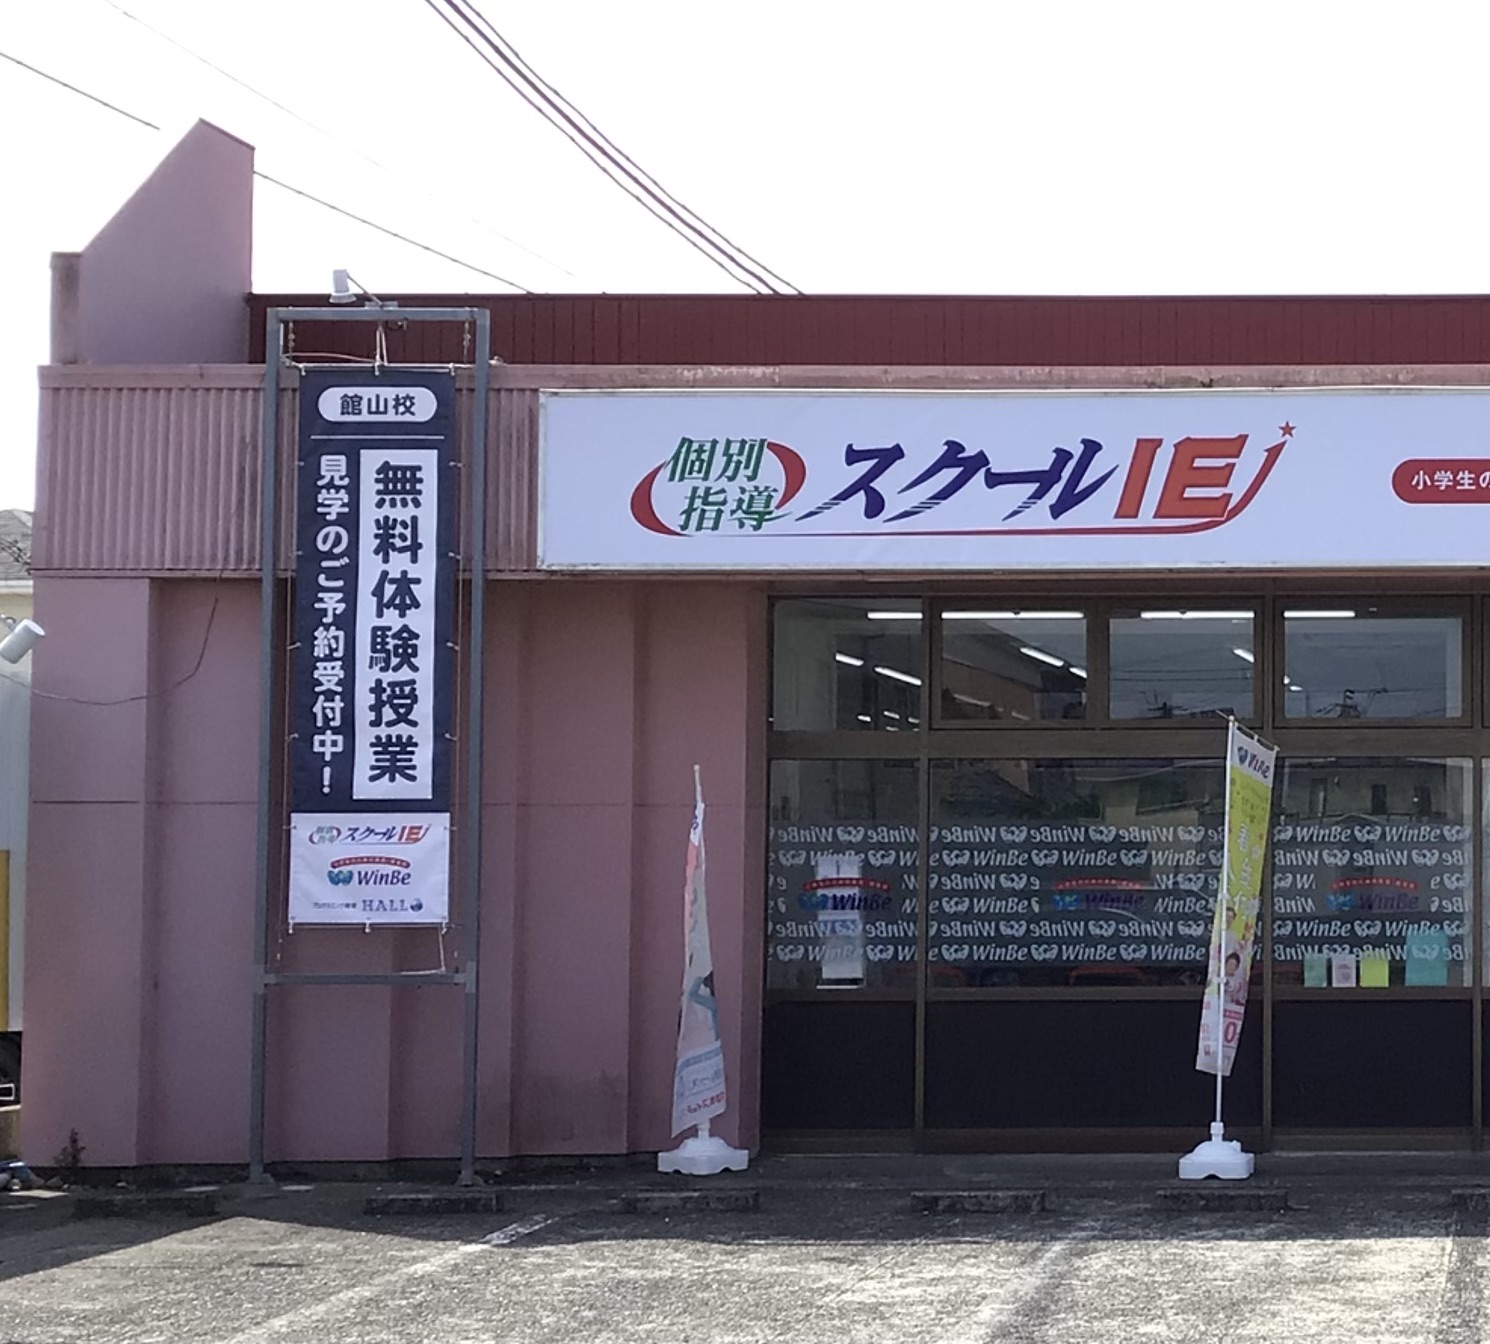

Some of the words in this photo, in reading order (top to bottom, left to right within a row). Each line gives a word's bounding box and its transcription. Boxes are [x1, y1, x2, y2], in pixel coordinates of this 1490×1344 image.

[339, 392, 417, 418] 館山校
[665, 436, 768, 482] 個別
[679, 485, 792, 532] 指導
[367, 460, 424, 785] 無料体験授業
[1296, 826, 1351, 843] WinBe
[1385, 826, 1440, 843] WinBe
[973, 850, 1028, 866] WinBe
[1062, 850, 1117, 866] WinBe
[1151, 850, 1206, 866] WinBe
[357, 869, 411, 886] WinBe
[973, 897, 1028, 913] WinBe
[1296, 920, 1351, 937] WinBe
[1385, 920, 1441, 937] WinBe
[972, 945, 1028, 961] WinBe
[1061, 945, 1117, 961] WinBe
[1150, 945, 1206, 961] WinBe
